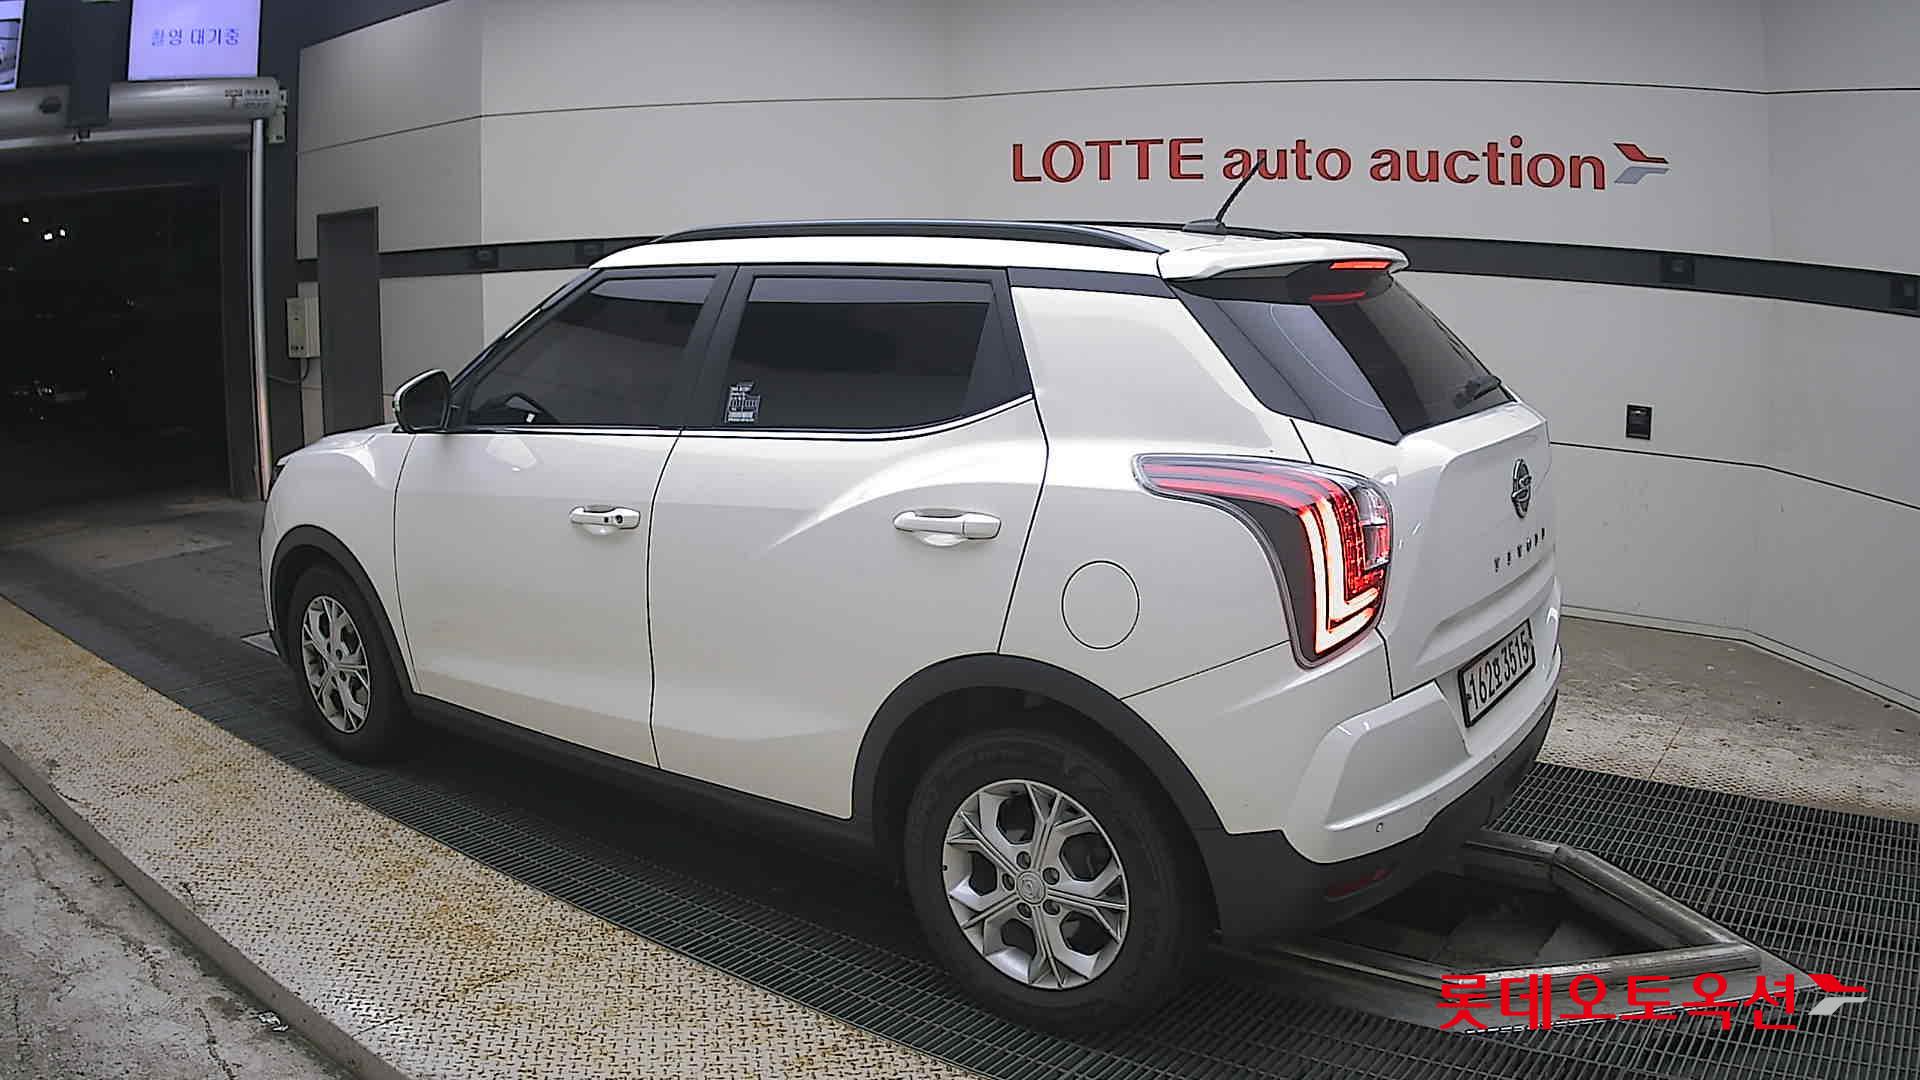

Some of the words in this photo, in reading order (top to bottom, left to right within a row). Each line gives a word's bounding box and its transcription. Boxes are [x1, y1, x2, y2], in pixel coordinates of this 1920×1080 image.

[190, 27, 240, 46] 대기중
[1012, 137, 1204, 184] LOTTE
[1222, 138, 1352, 181] auto
[1368, 135, 1606, 190] auction
[1500, 629, 1529, 682] 3515
